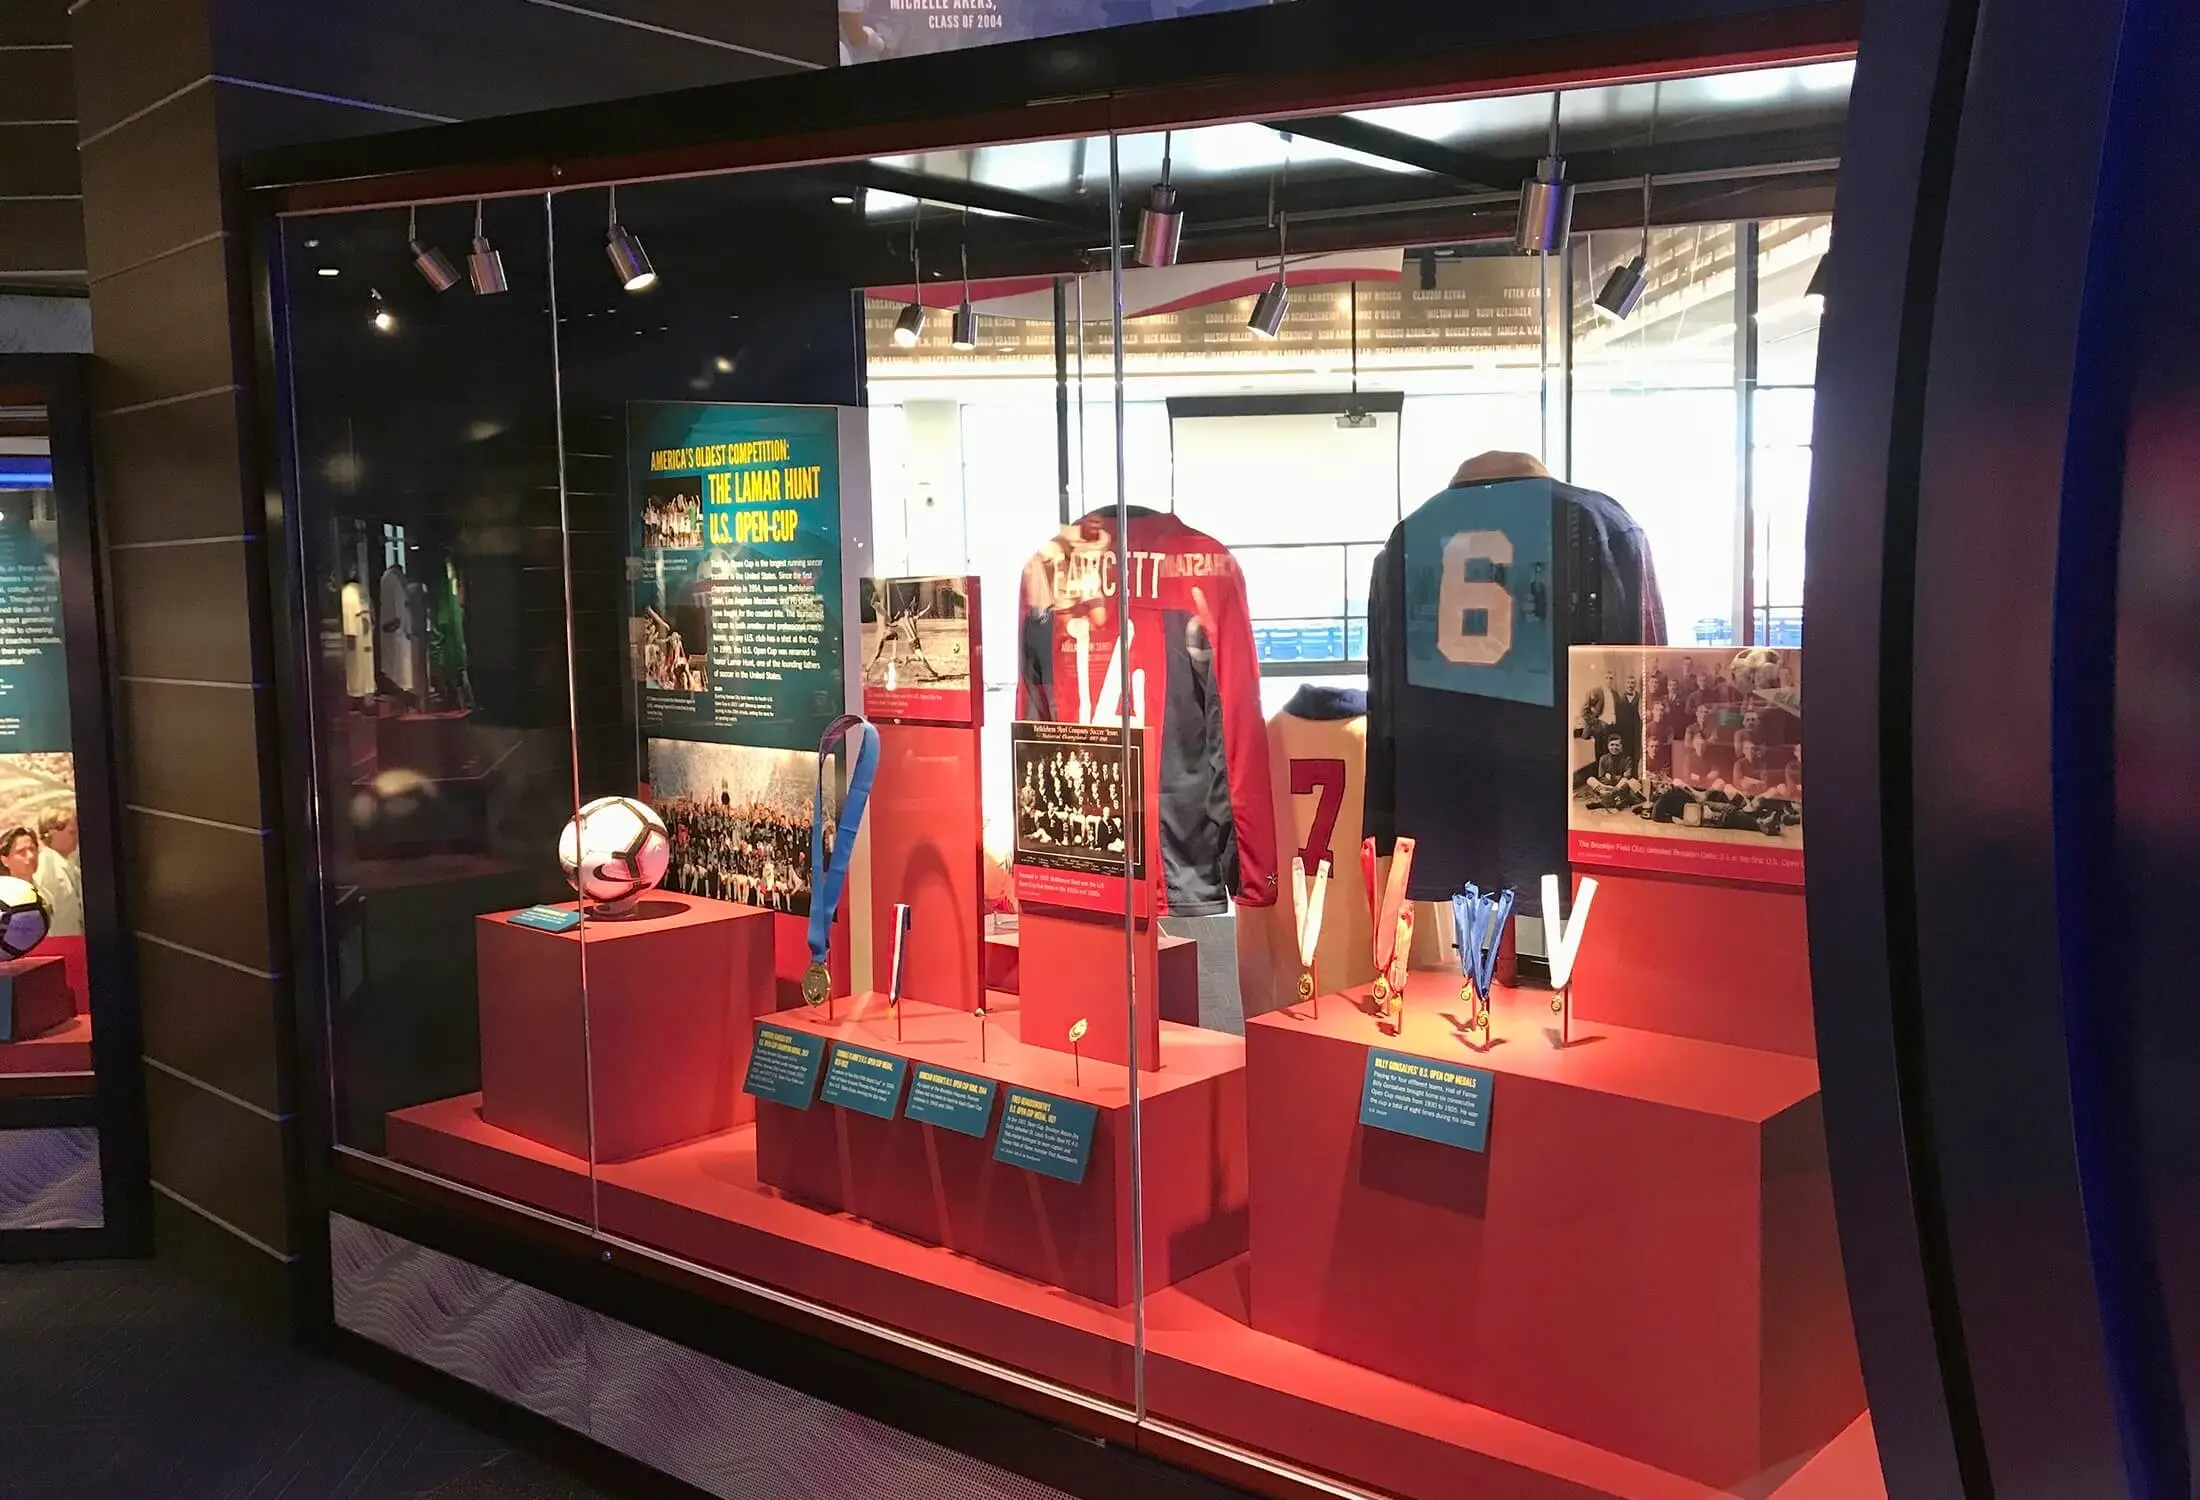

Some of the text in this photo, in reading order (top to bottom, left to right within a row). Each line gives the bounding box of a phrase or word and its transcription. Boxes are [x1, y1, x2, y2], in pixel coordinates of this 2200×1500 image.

[890, 0, 997, 11] MICHELLE AKERS,
[928, 14, 1003, 28] CLASS OF 2004
[1503, 288, 1525, 299] PETER
[651, 439, 790, 471] AMERICA'S OLDEST COMPETITION:
[708, 466, 820, 504] THE LAMAR HUNT
[710, 510, 798, 545] U.S. OPEN CUP
[744, 559, 754, 568] Cup
[760, 559, 768, 568] the
[769, 559, 786, 568] longest
[744, 572, 760, 580] United
[778, 571, 792, 579] Since
[1053, 550, 1166, 599] FAWCTT
[1437, 530, 1514, 665] 6
[767, 622, 776, 630] and
[744, 634, 753, 643] U.S.
[755, 634, 765, 643] club
[742, 646, 752, 655] U.S.
[753, 646, 766, 655] Open
[767, 646, 777, 655] Cup
[778, 646, 787, 655] was
[781, 659, 803, 667] founding
[749, 670, 765, 678] United
[1290, 759, 1345, 878] 7
[1578, 840, 1590, 848] The
[1373, 1070, 1389, 1080] Playing
[1419, 1066, 1429, 1078] U.S.
[1430, 1068, 1443, 1081] OPEN
[1444, 1072, 1455, 1083] CUP
[1455, 1074, 1476, 1088] MEDALS
[1371, 1088, 1383, 1096] Open
[1384, 1090, 1394, 1099] Cup
